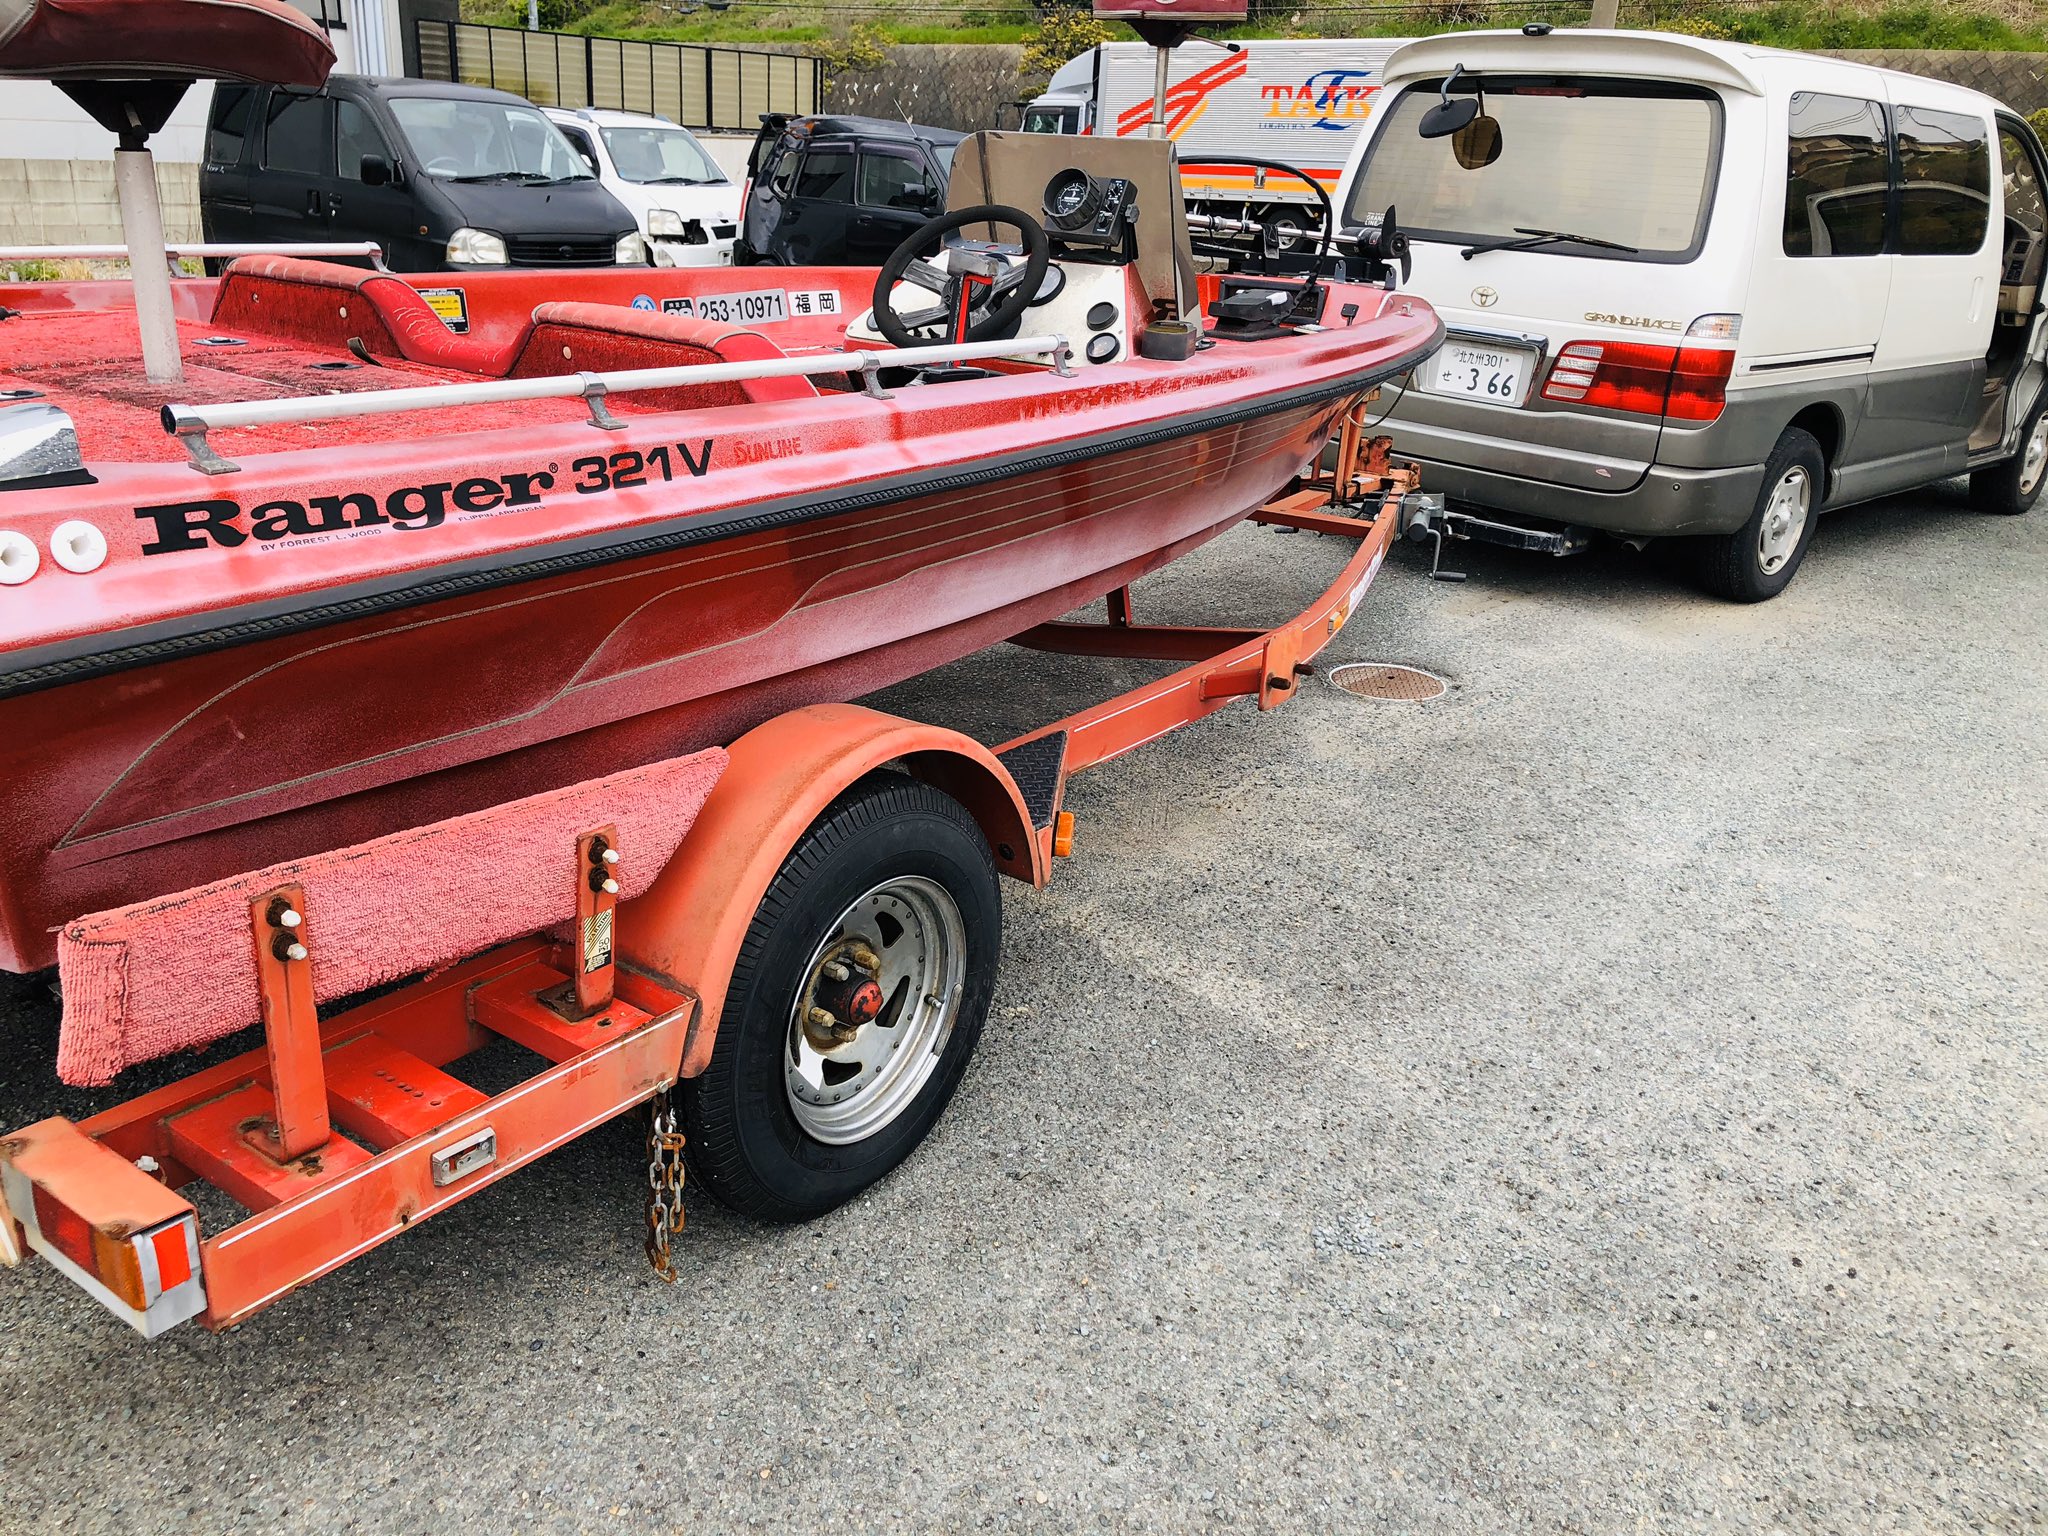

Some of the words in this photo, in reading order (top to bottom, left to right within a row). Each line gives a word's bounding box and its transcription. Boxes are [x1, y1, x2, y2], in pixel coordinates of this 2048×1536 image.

[796, 292, 834, 313] 福岡
[1442, 370, 1452, 382] せ
[733, 436, 803, 465] SUNLINE
[261, 543, 276, 552] BY
[280, 535, 331, 549] FORREST
[348, 528, 382, 539] WOOD
